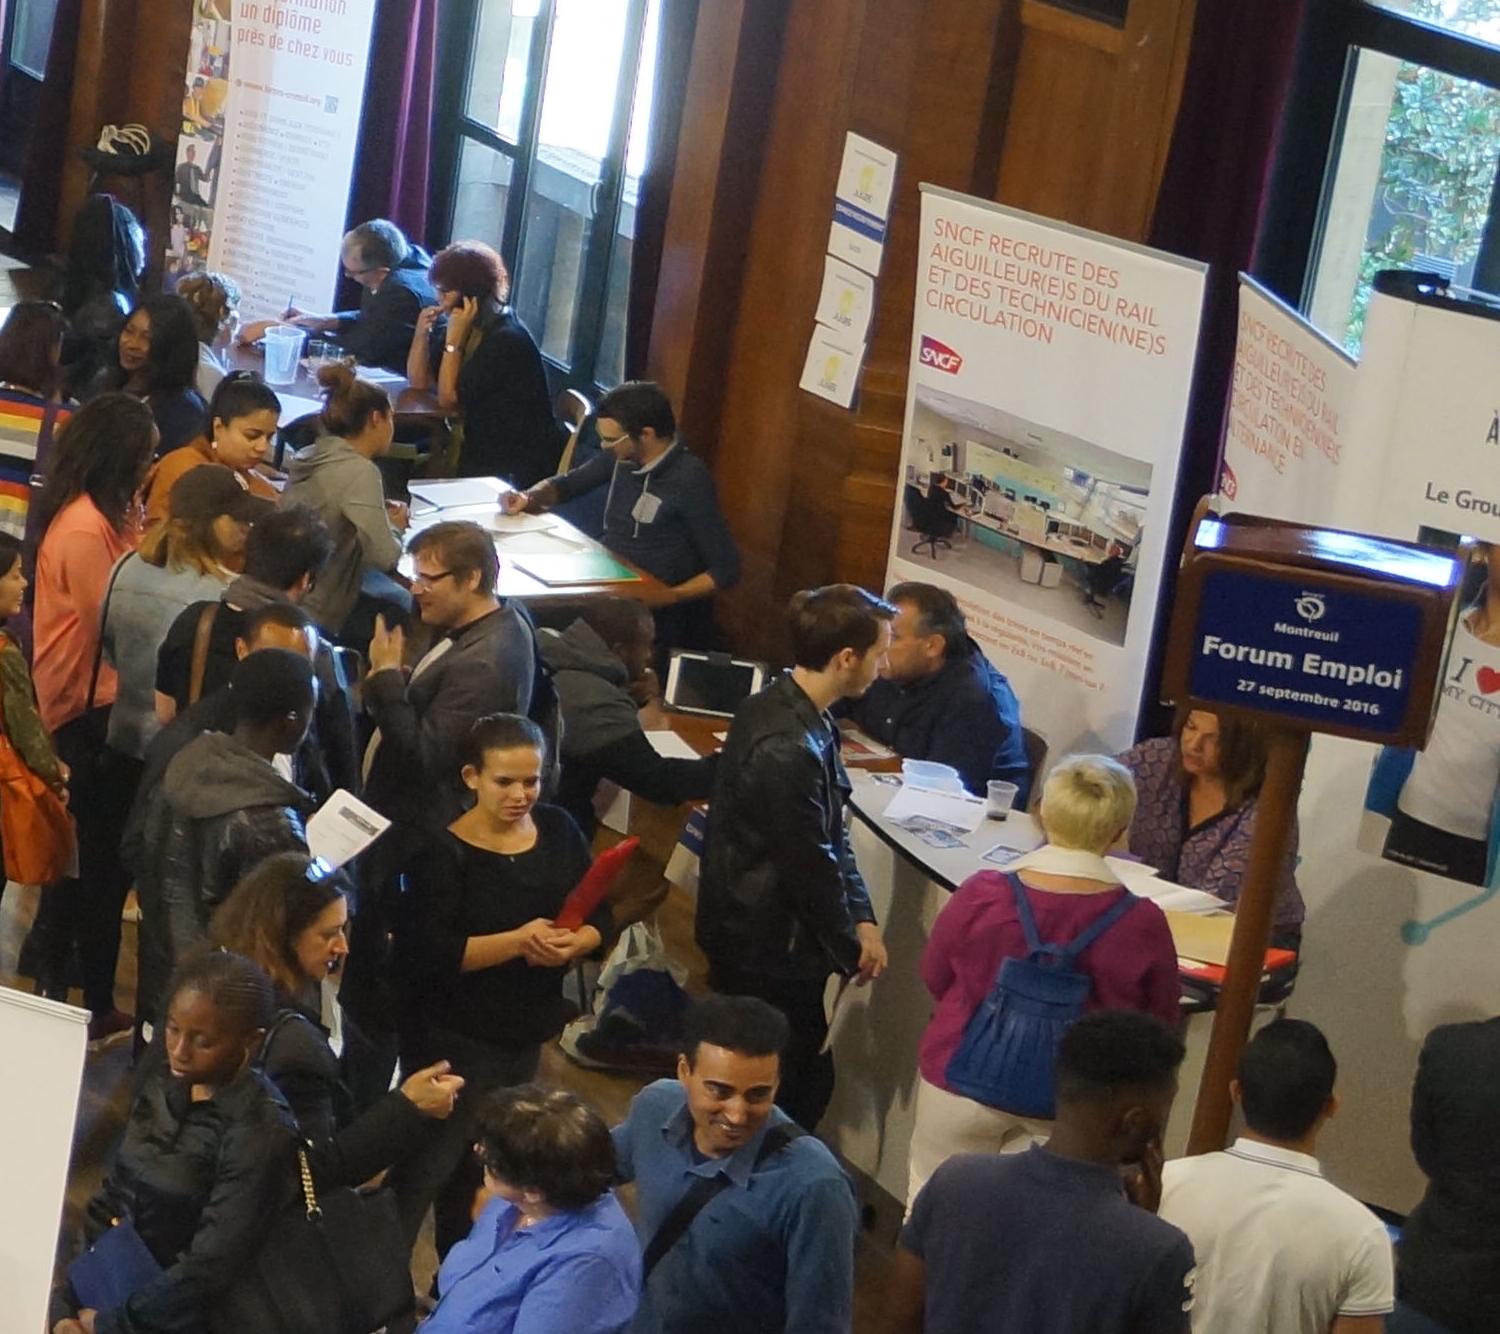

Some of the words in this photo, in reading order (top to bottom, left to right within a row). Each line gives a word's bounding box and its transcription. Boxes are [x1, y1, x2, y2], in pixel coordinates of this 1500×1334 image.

[240, 2, 258, 19] un
[262, 4, 322, 35] diplôme
[237, 27, 265, 46] près
[269, 32, 284, 51] de
[287, 39, 320, 60] chez
[322, 46, 353, 67] vous
[933, 217, 985, 247] SNCF
[989, 234, 1077, 277] RECRUTE
[1081, 261, 1120, 289] DES
[930, 242, 1077, 301] AIGUILLEUR(E)S
[1082, 287, 1110, 312] DU
[1115, 298, 1159, 327] RAIL
[926, 288, 1054, 344] CIRCULATION
[928, 264, 951, 285] ET
[954, 273, 991, 300] DES
[997, 284, 1167, 356] TECHNICIEN(NE)S
[920, 346, 961, 370] SNCF
[1425, 481, 1449, 504] Le
[1273, 621, 1340, 643] Montreuil
[1202, 634, 1293, 671] Forum
[1302, 653, 1403, 691] Emploi
[1450, 656, 1473, 683] I
[1236, 679, 1256, 692] 27
[1258, 682, 1341, 710] septembre
[1342, 698, 1380, 716] 2016
